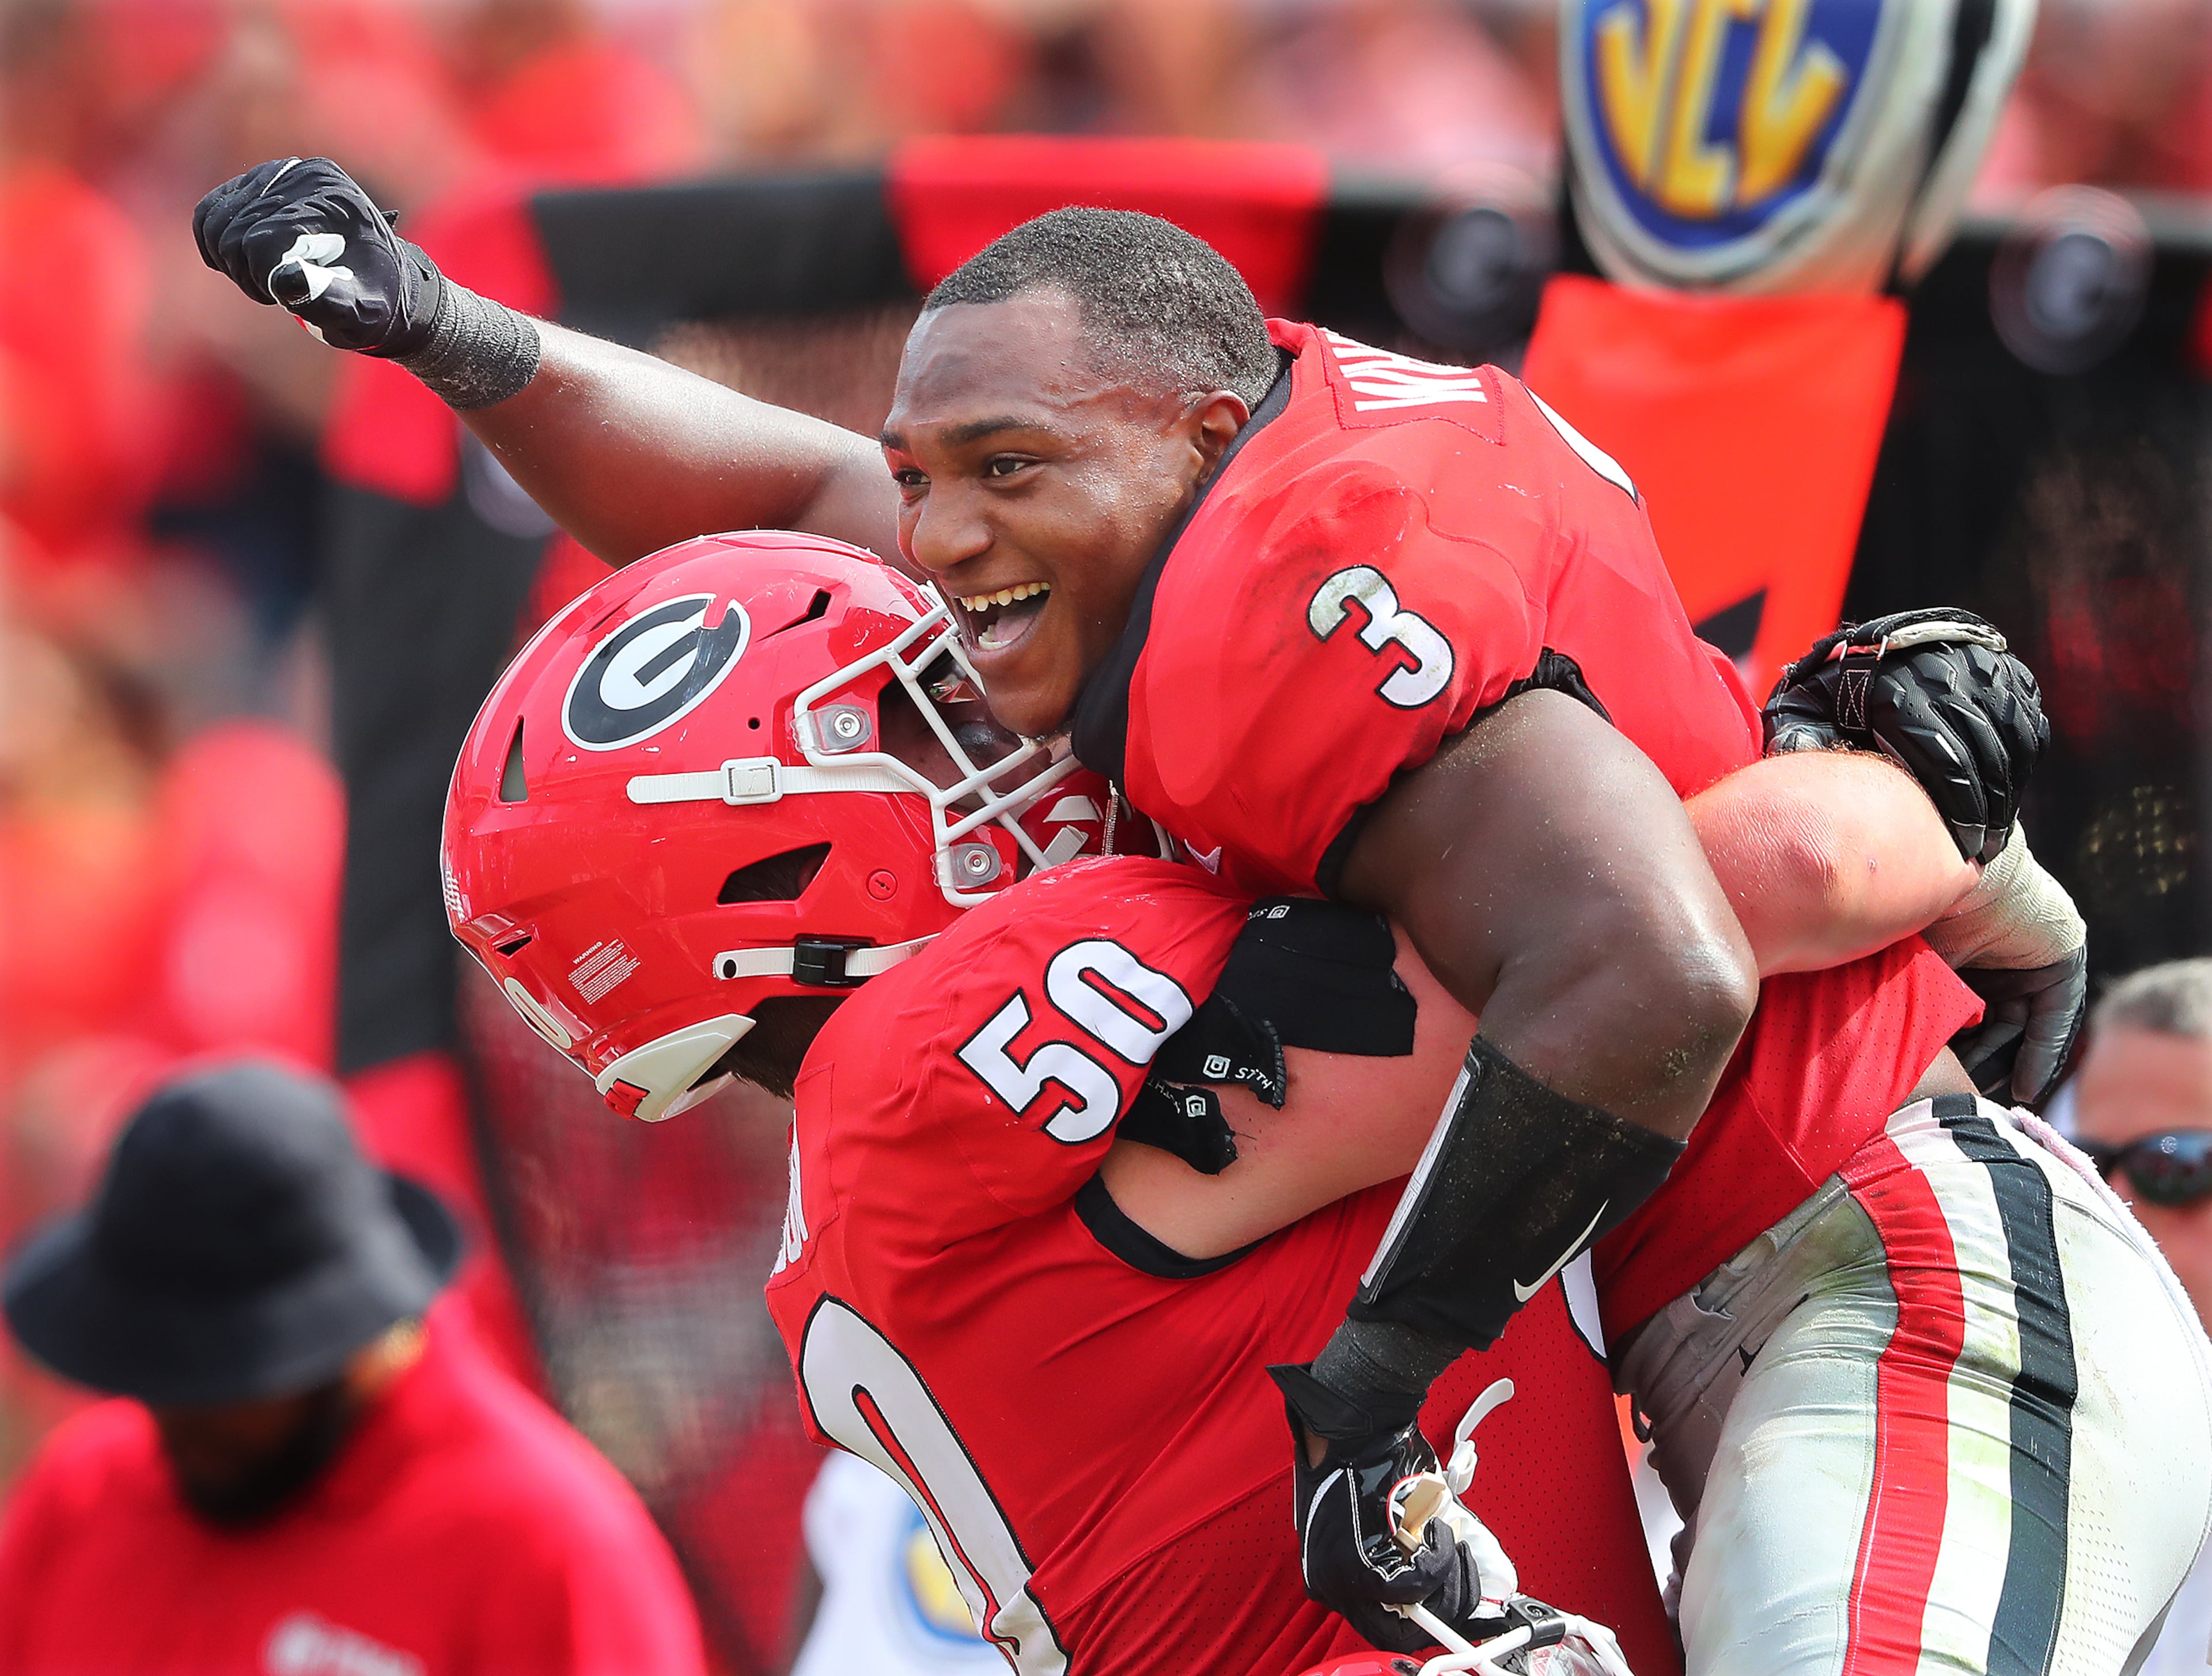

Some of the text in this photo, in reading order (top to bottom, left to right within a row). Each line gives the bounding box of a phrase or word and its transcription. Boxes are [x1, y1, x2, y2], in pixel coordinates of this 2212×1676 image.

[561, 593, 751, 752] G
[1306, 564, 1456, 710] 3
[573, 941, 603, 965] WARNING
[954, 938, 1195, 1146] 50
